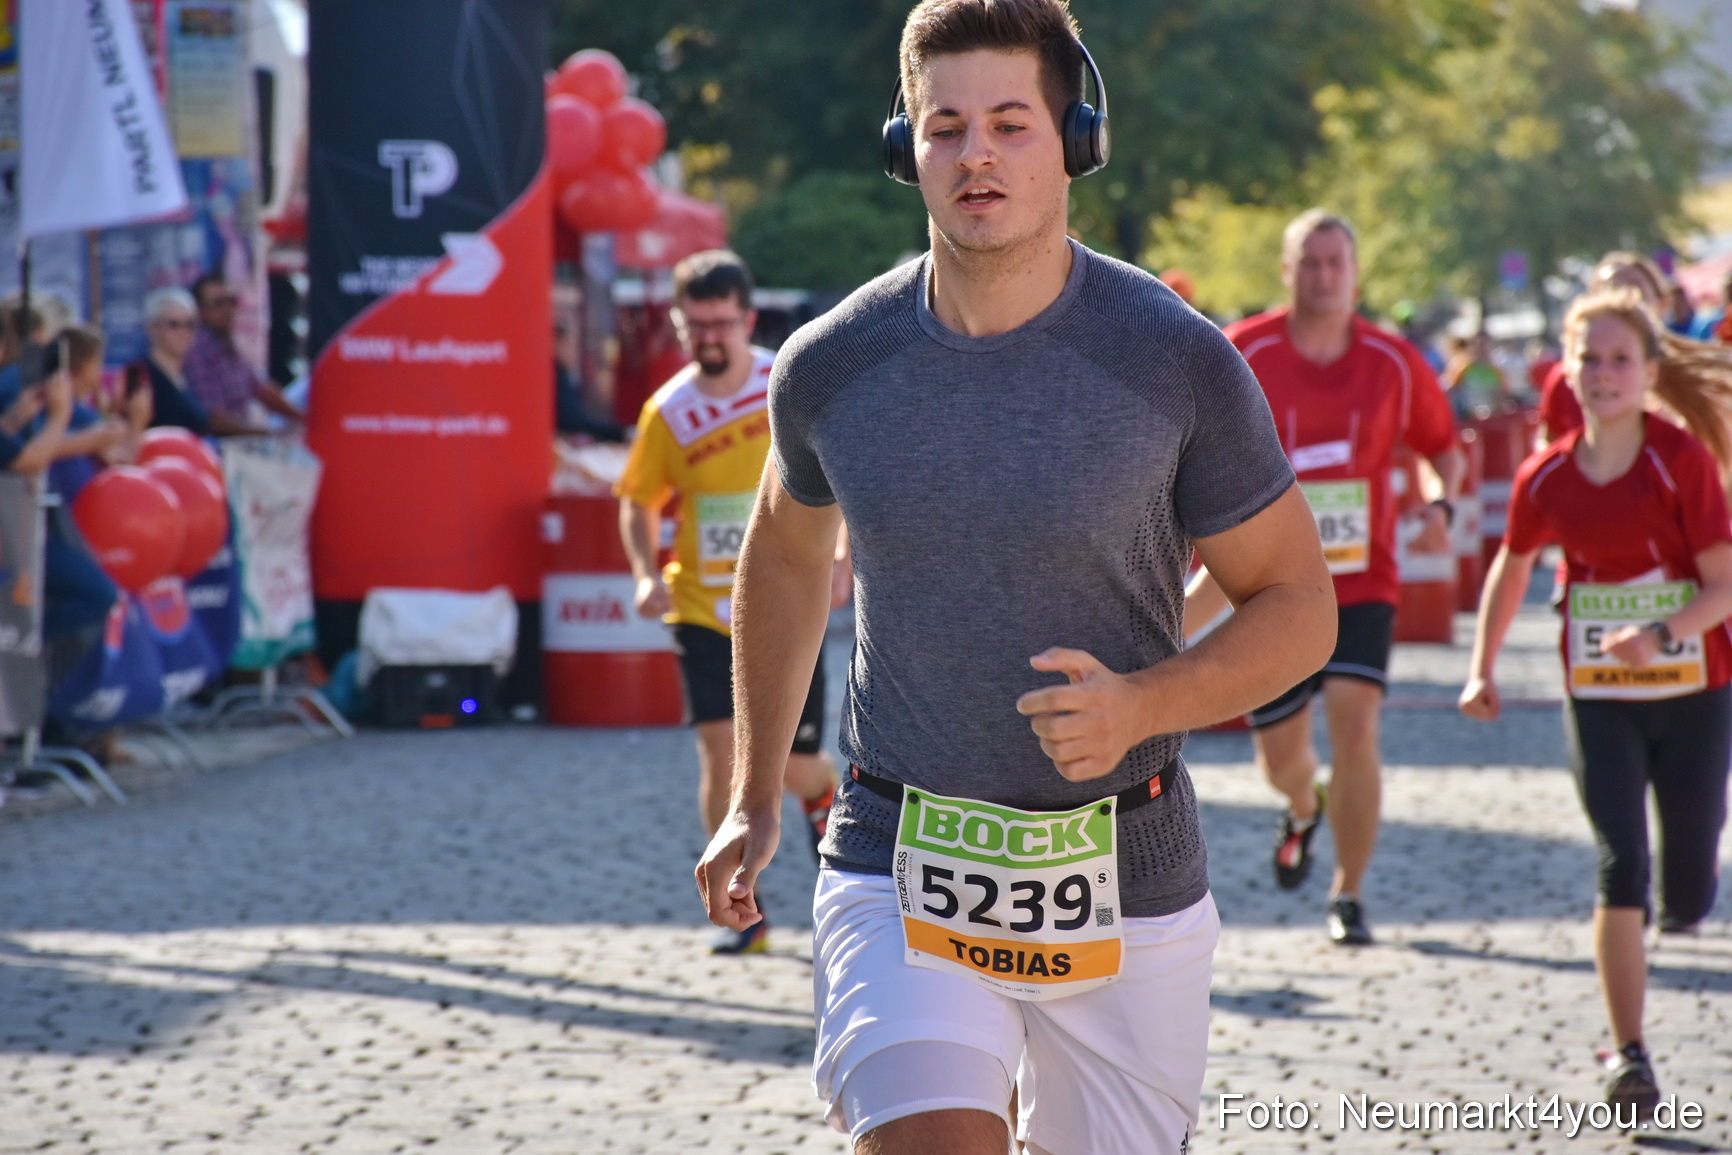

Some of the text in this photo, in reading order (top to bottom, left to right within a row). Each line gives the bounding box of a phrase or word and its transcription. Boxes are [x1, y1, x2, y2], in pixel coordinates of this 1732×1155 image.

[113, 91, 156, 193] PARTL
[1579, 591, 1677, 612] BOCK
[1593, 669, 1680, 683] KATHRIN
[918, 801, 1097, 859] BOCK
[922, 864, 1091, 933] 5239
[948, 938, 1072, 977] TOBIAS
